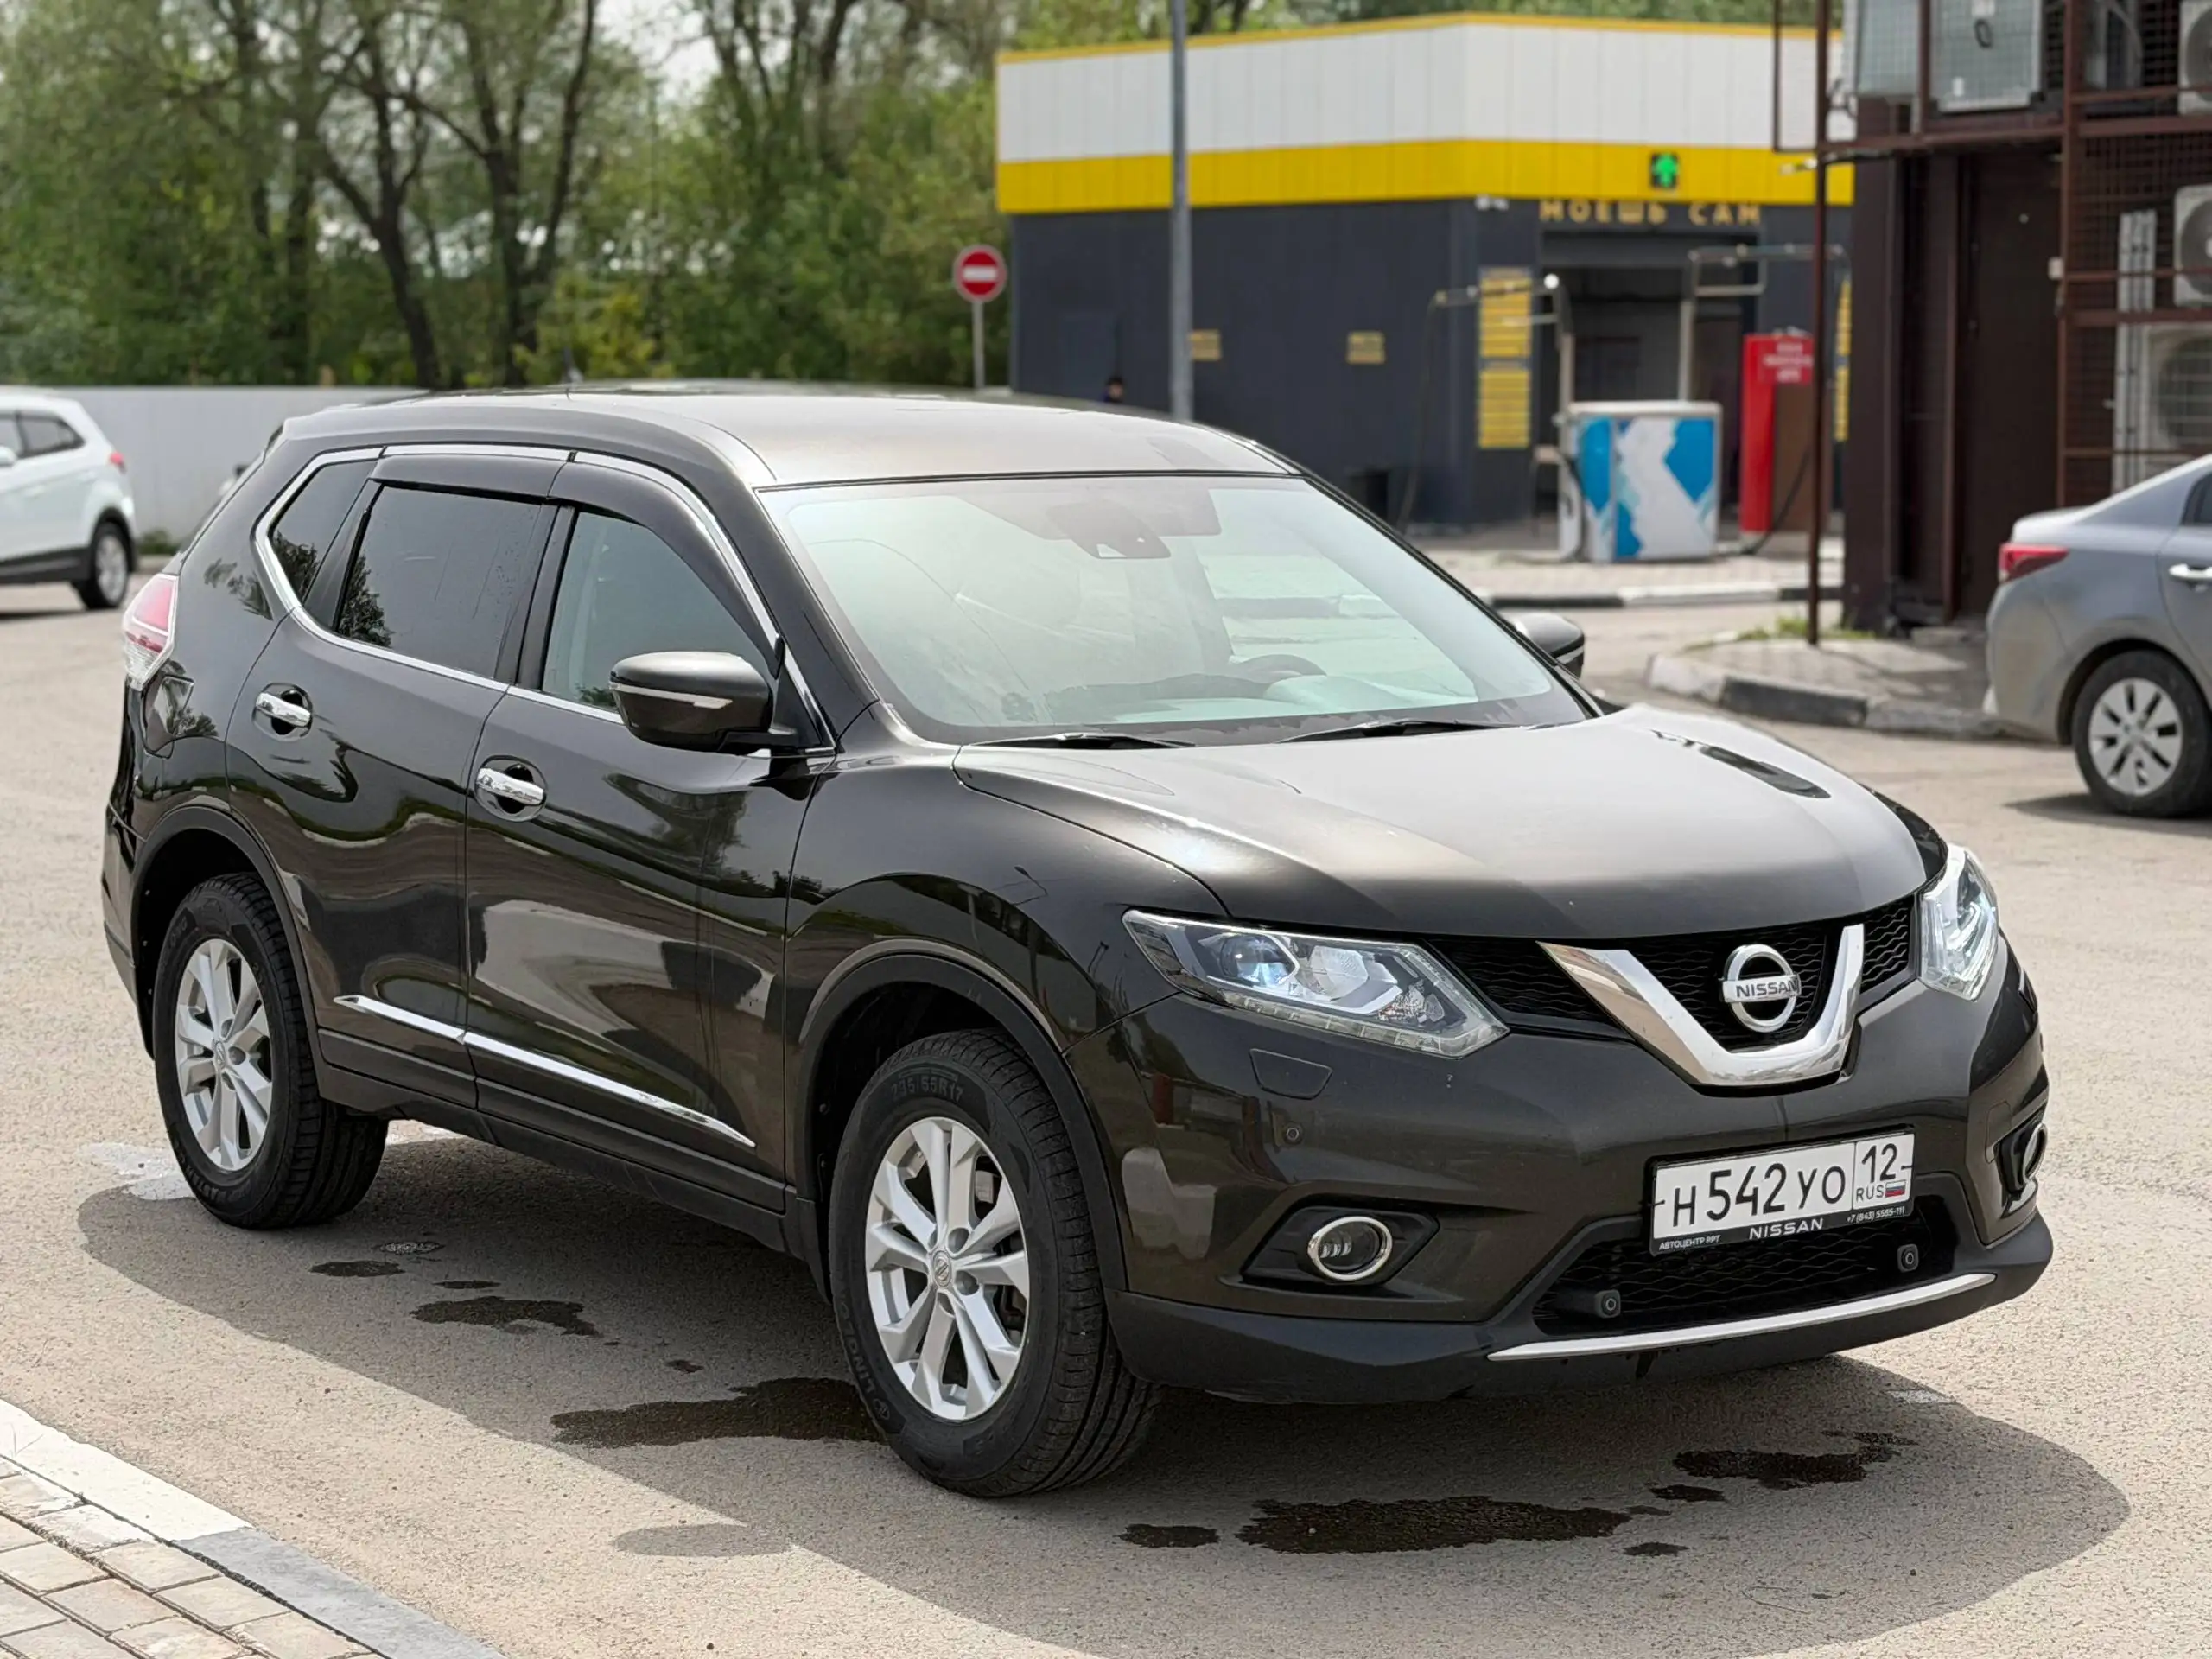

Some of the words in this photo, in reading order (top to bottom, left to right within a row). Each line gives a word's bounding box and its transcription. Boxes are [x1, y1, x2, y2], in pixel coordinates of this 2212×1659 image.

[1688, 201, 1762, 226] САМ
[1736, 980, 1798, 998] NISSAN
[1861, 1142, 1898, 1184] 12
[1856, 1182, 1885, 1203] RUS
[1748, 1217, 1823, 1240] NISSAN
